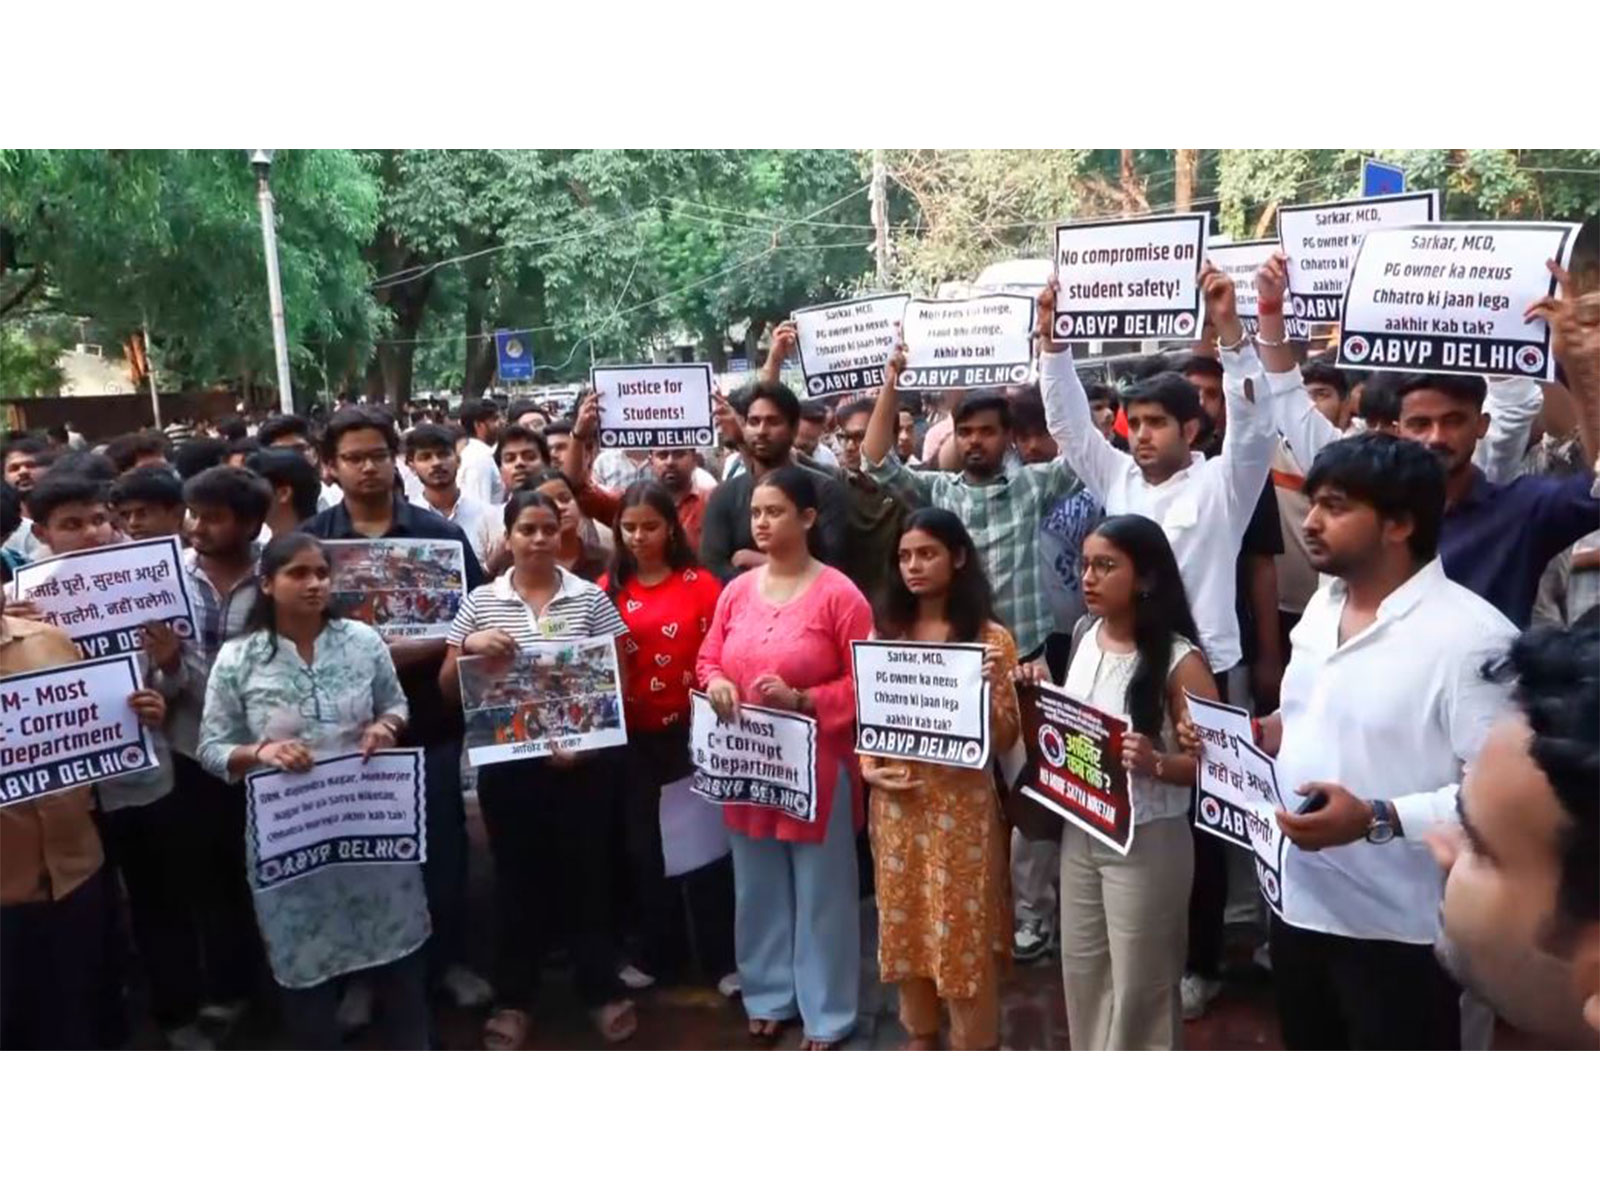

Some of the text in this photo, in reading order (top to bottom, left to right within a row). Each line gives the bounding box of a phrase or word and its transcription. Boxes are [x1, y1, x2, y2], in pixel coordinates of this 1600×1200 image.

[1315, 208, 1381, 226] Sarkar, MCD,
[1303, 237, 1315, 248] PG
[1317, 235, 1348, 248] owner
[1411, 235, 1496, 252] Sarkar, MCD,
[1060, 242, 1194, 266] No compromise on
[1301, 257, 1349, 271] Chhatro ki
[1384, 262, 1513, 280] PG owner ka nexus
[1069, 278, 1180, 300] student safety!
[1313, 280, 1343, 292] aakhir
[1307, 299, 1343, 318] ABV
[1373, 288, 1510, 311] Chhatro ki jaan lega
[1074, 313, 1174, 336] ABVP DELHI
[1385, 317, 1495, 335] aakhir Kab tak?
[934, 346, 959, 359] Akhir
[975, 346, 995, 357] tak!
[1370, 338, 1513, 369] ABVP DELHI
[826, 372, 858, 390] ABVP
[917, 366, 1010, 385] ABVP DELHI
[618, 379, 682, 398] Justice for
[623, 406, 685, 421] Students!
[618, 430, 696, 445] ABVP DELHI
[91, 569, 132, 592] सुरक्षा
[888, 650, 946, 666] Sarkar, MCD,
[876, 671, 958, 688] PG owner ka nexus
[1, 677, 88, 713] M- Most
[874, 691, 959, 712] Chhatro ki jaan lega
[20, 702, 99, 736] Corrupt
[740, 716, 774, 738] Most
[886, 713, 913, 727] aakhir
[933, 716, 952, 732] tak?
[1, 722, 123, 767] Department
[708, 732, 782, 761] C- Corrupt
[876, 730, 963, 761] ABVP DELHI
[58, 751, 123, 785] DELHI
[710, 753, 799, 785] Department
[750, 780, 793, 808] DELHI
[281, 838, 394, 876] ABVP DELHI
